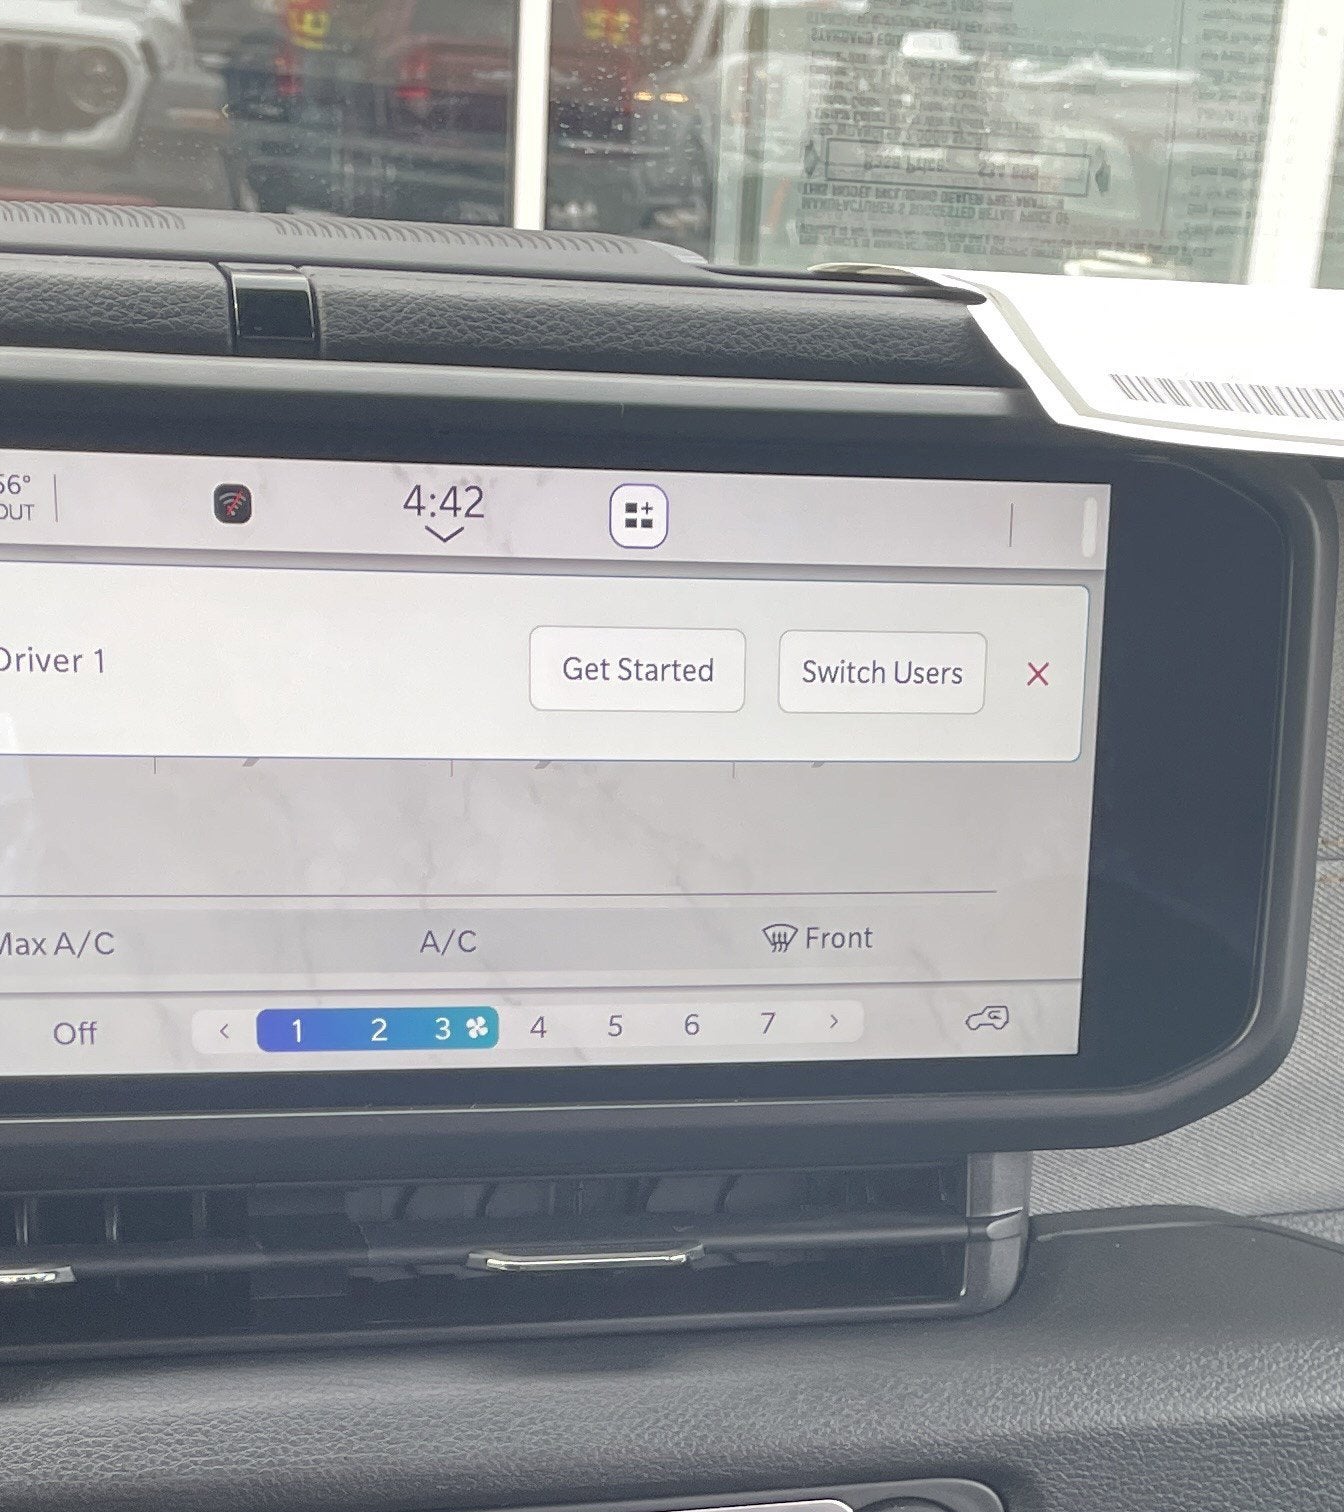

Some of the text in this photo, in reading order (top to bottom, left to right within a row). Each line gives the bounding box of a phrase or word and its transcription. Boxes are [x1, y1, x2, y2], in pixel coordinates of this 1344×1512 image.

[403, 484, 485, 519] 4:42
[94, 648, 105, 673] 1
[561, 656, 715, 683] Get Started
[801, 658, 964, 686] Switch Users
[53, 929, 116, 959] A/C
[419, 927, 478, 956] A/C
[805, 925, 873, 952] Front
[53, 1021, 99, 1046] Off
[291, 1012, 776, 1043] 1 2 3 4 5 6 7
